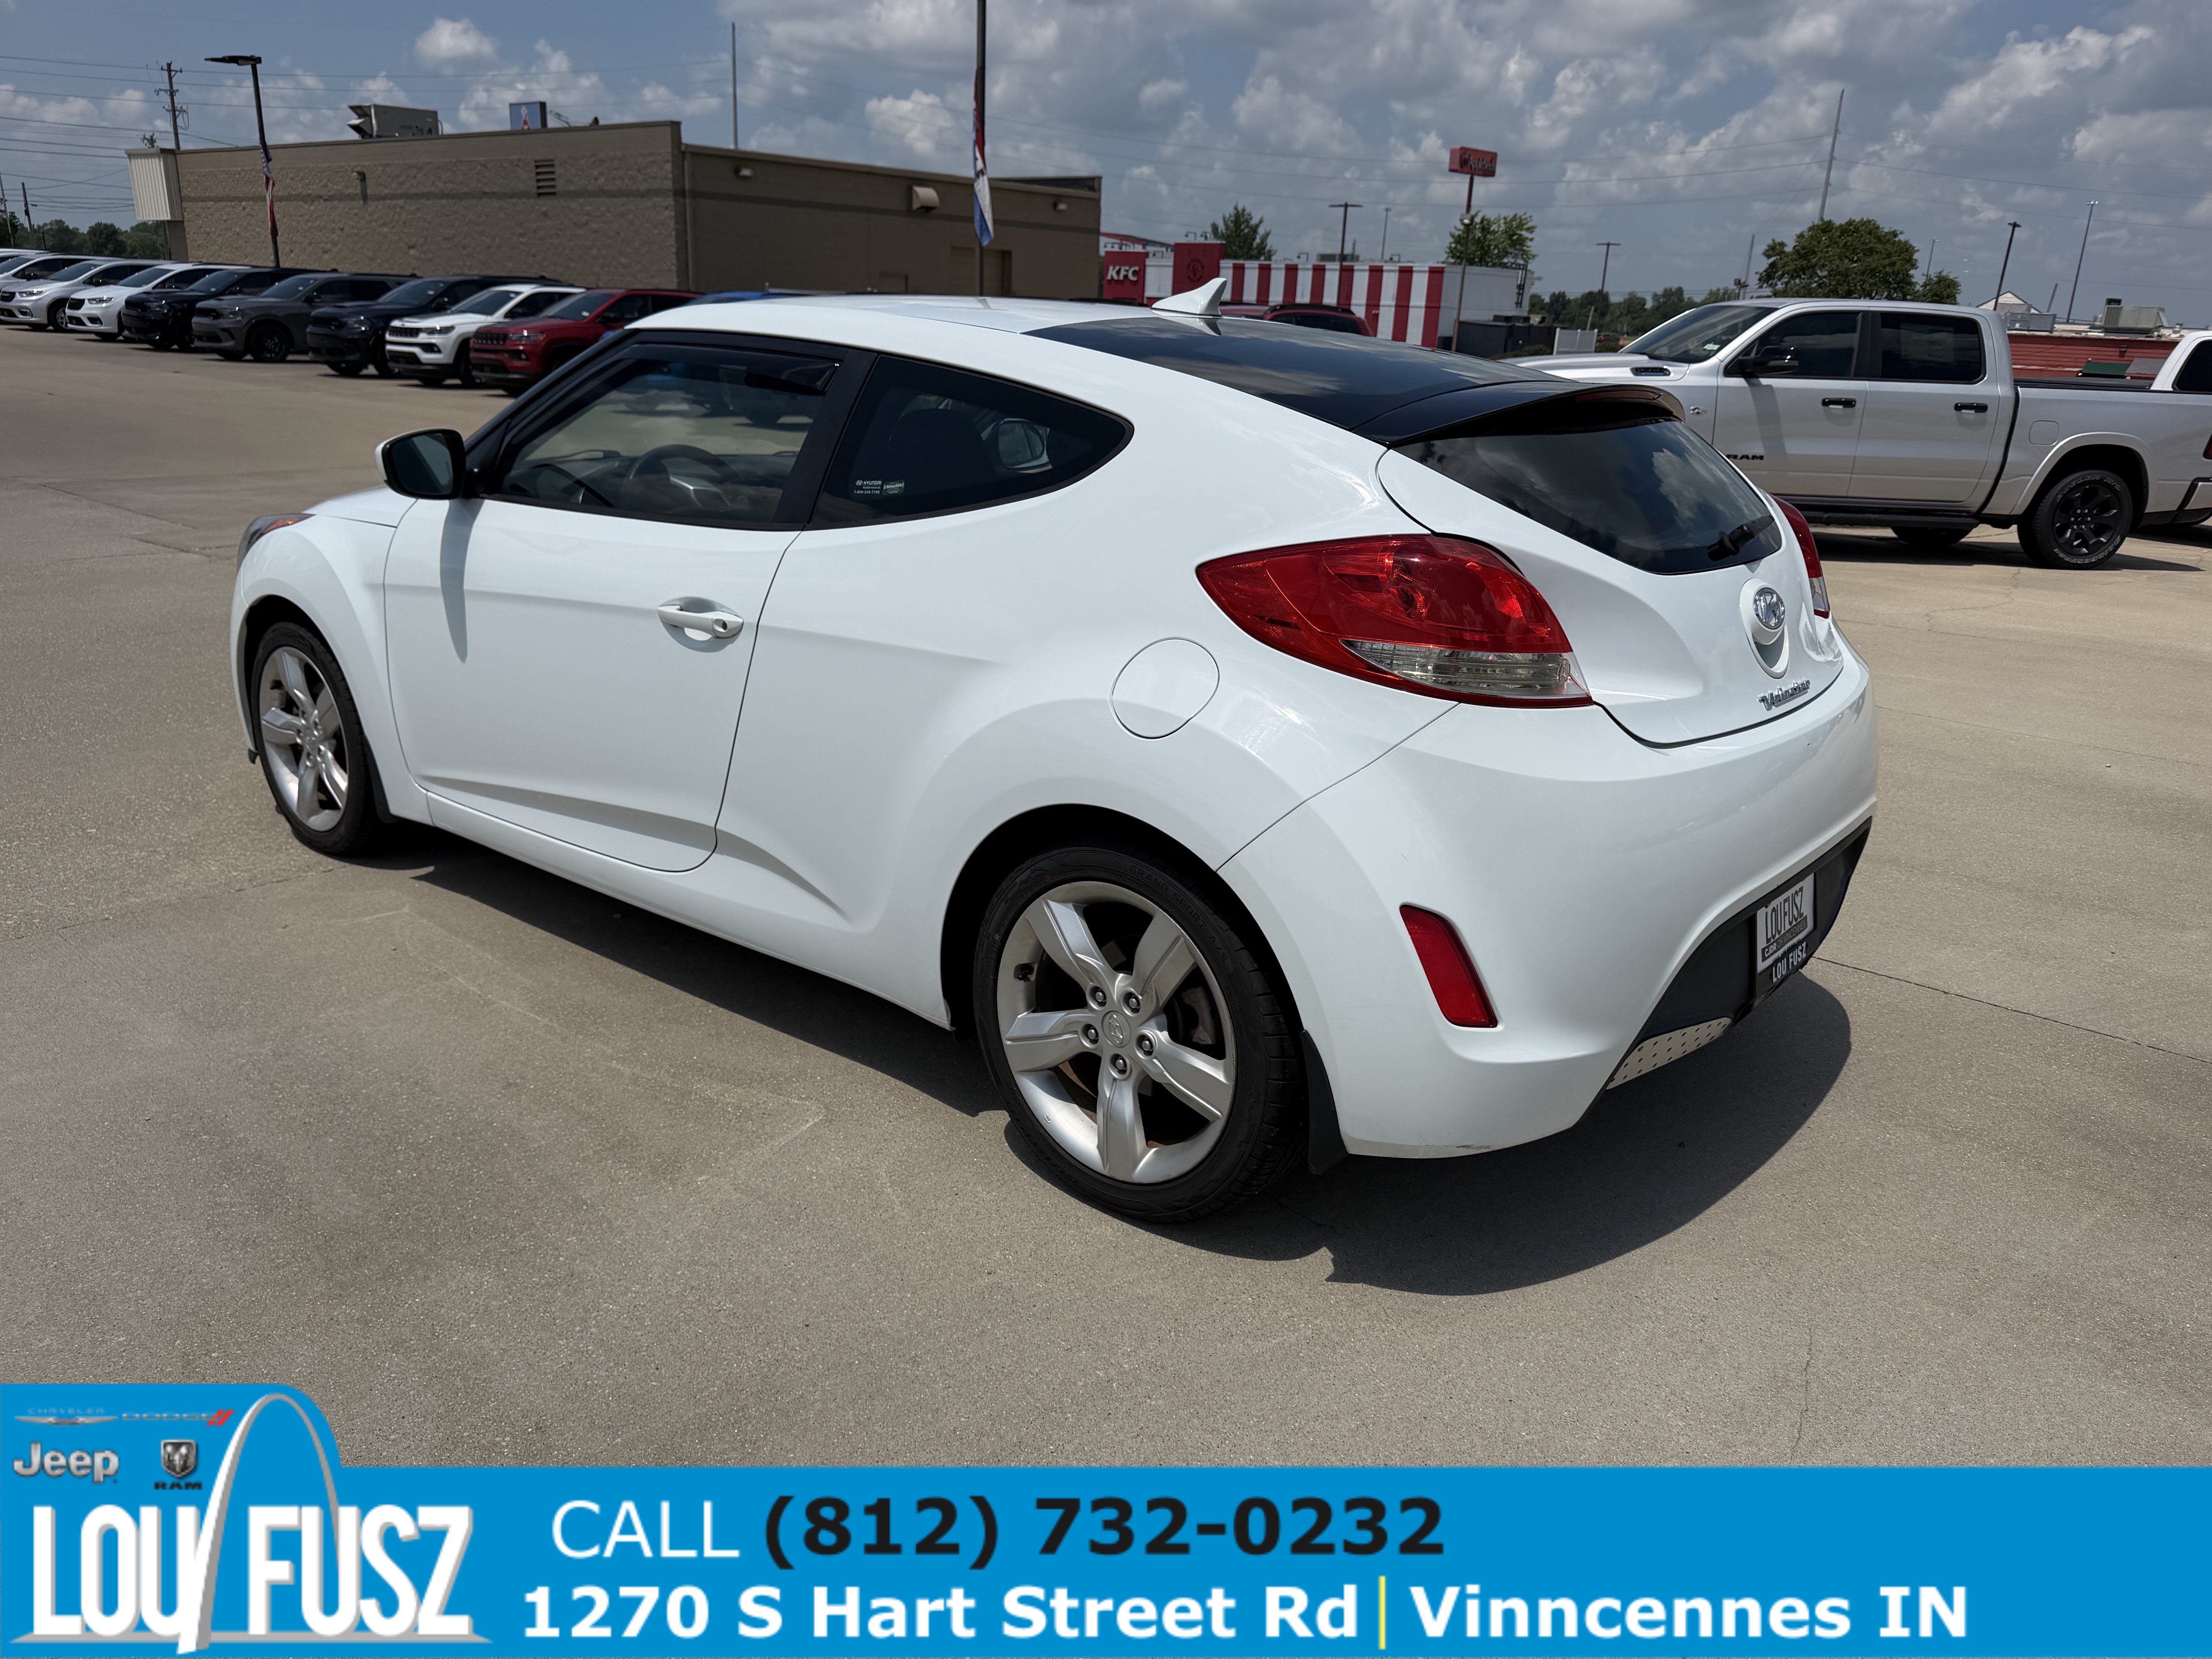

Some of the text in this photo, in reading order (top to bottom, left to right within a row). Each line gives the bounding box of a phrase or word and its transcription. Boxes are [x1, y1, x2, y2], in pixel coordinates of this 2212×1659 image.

[1107, 266, 1139, 281] KFC
[1129, 864, 1228, 962] GRAND SPORT A/S
[1765, 885, 1804, 945] LOU FUSZ
[1765, 943, 1777, 957] CJDR
[1772, 957, 1786, 983] LOU
[1789, 941, 1807, 970] FUSZ
